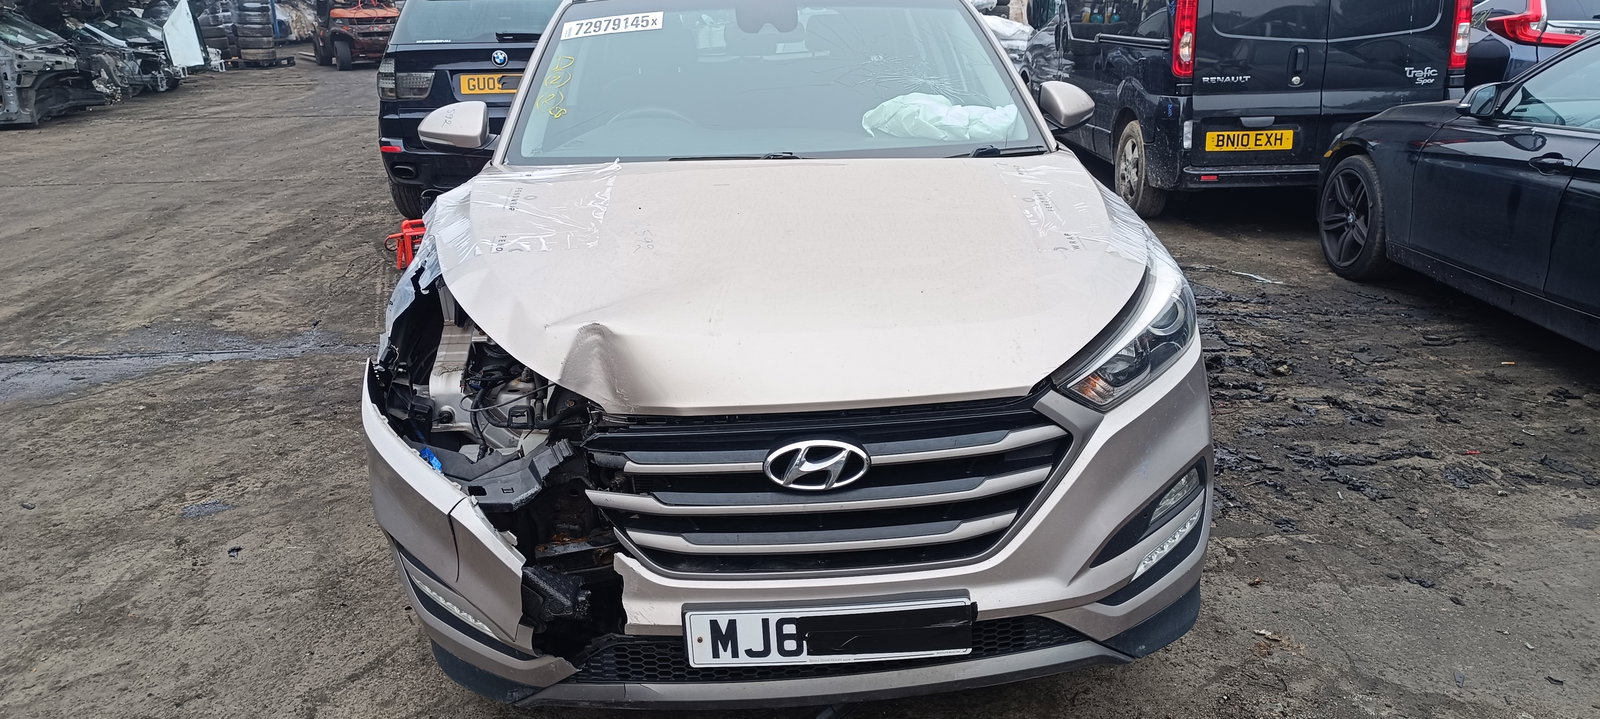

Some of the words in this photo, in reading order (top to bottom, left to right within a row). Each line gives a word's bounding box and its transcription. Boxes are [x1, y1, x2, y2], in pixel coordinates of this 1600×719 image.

[1404, 66, 1439, 78] Trafic
[1215, 133, 1250, 147] BN10
[1254, 133, 1283, 146] EXH
